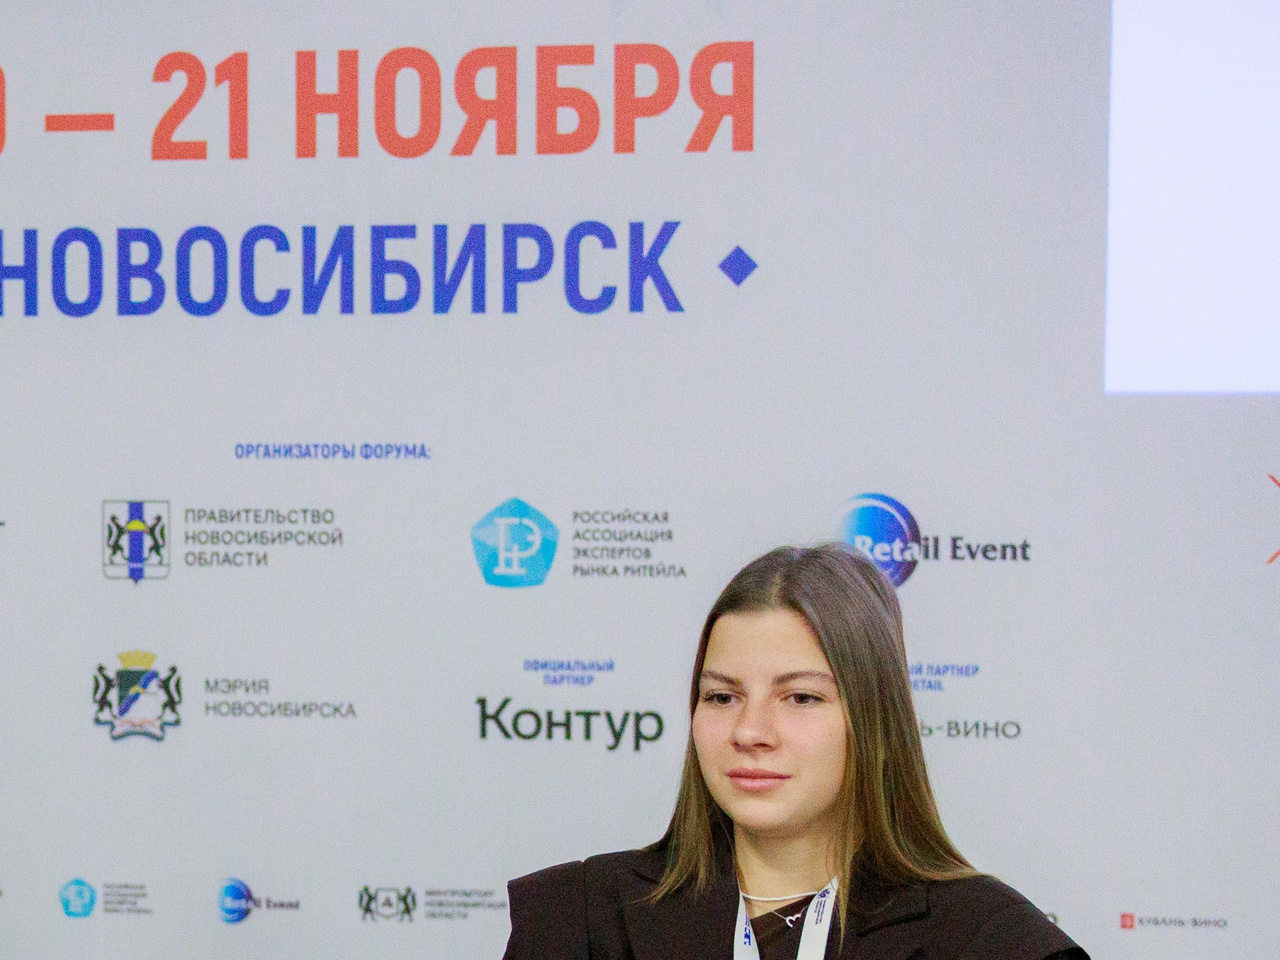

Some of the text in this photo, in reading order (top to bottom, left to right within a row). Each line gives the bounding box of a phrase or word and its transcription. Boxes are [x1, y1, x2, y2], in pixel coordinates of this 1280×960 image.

[151, 51, 248, 160] 21
[296, 41, 754, 158] НОЯБРЯ
[235, 443, 429, 460] ОРГАНИЗАТОРЫ ФОРУМА:
[185, 508, 334, 524] ПРАВИТЕЛЬСТВО
[573, 509, 669, 523] РОССИЙСКАЯ
[185, 526, 343, 546] НОВОСИБИРСКОЙ
[573, 529, 673, 543] АССОЦИАЦИЯ
[574, 547, 652, 559] ЭКСПЕРТОВ
[854, 534, 1030, 561] Retail Event
[184, 551, 268, 567] ОБЛАСТИ
[573, 563, 686, 577] РЫНКА РИТЕЙЛА
[523, 658, 614, 673] ОФИЦИАЛЬНЫЙ
[927, 664, 979, 677] ПАРТНЕР
[205, 679, 269, 694] МЭРИЯ
[544, 674, 594, 686] ПАРТНЕР
[205, 701, 356, 718] НОВОСИБИРСКА
[476, 698, 664, 751] Контур
